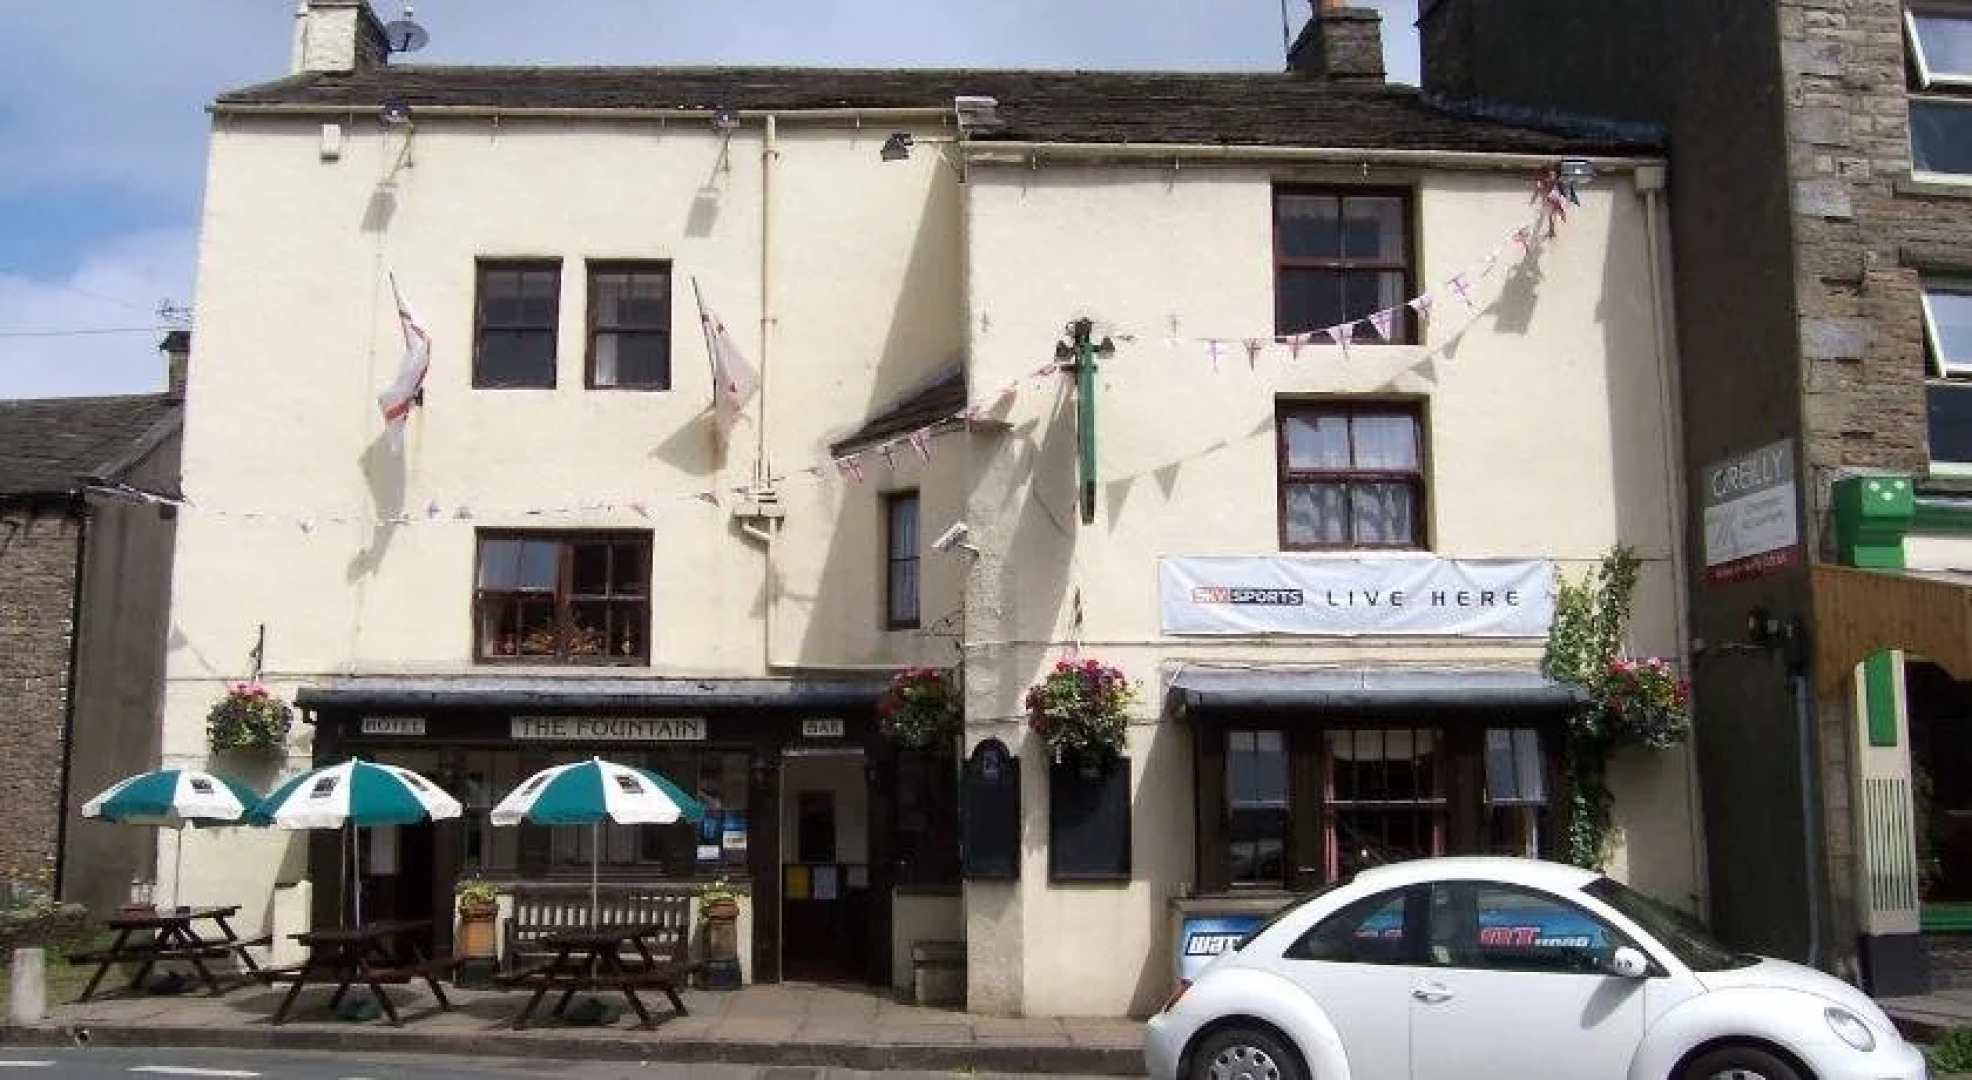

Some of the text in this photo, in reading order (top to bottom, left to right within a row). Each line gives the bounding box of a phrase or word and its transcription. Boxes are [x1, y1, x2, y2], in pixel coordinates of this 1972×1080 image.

[1194, 587, 1520, 606] SKY SPORTS LIVE HERE
[521, 718, 699, 738] THE FOUNTAIN
[806, 720, 840, 733] BAR
